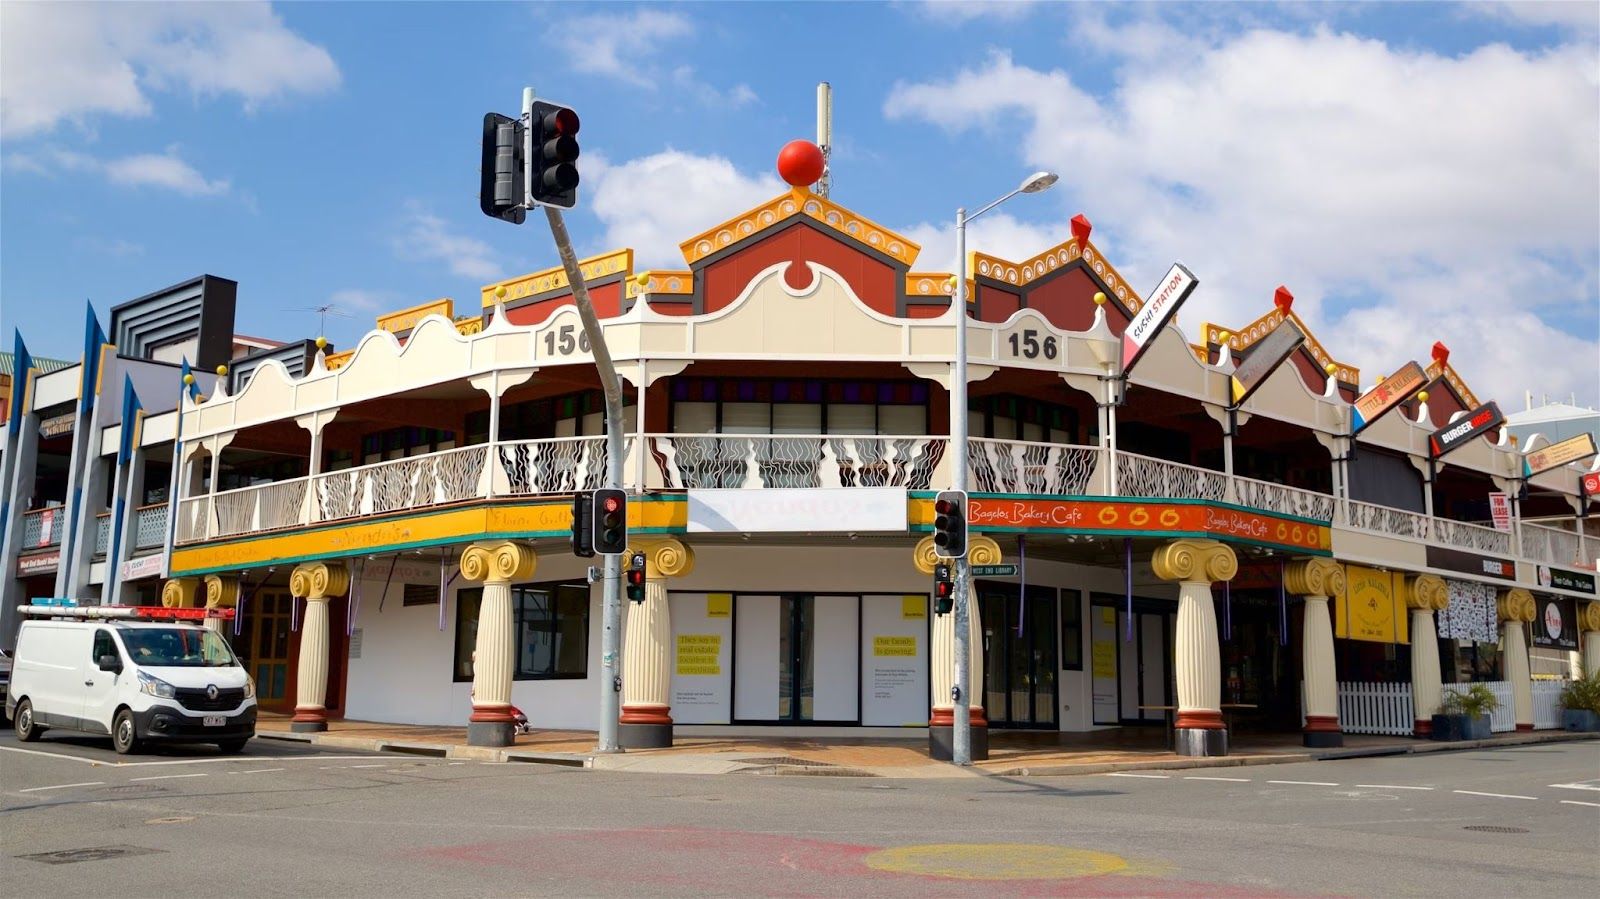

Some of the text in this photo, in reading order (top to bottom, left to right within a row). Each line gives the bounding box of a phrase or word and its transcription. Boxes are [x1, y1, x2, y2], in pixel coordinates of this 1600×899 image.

[1134, 273, 1182, 339] SUSHI STATION
[544, 324, 592, 356] 156
[1008, 329, 1058, 360] 156
[1441, 420, 1474, 444] BURGER
[1493, 497, 1505, 506] FOR
[1493, 507, 1508, 516] LEASE
[1008, 502, 1050, 524] Bakery
[1051, 506, 1082, 525] Cafe
[891, 637, 912, 647] family
